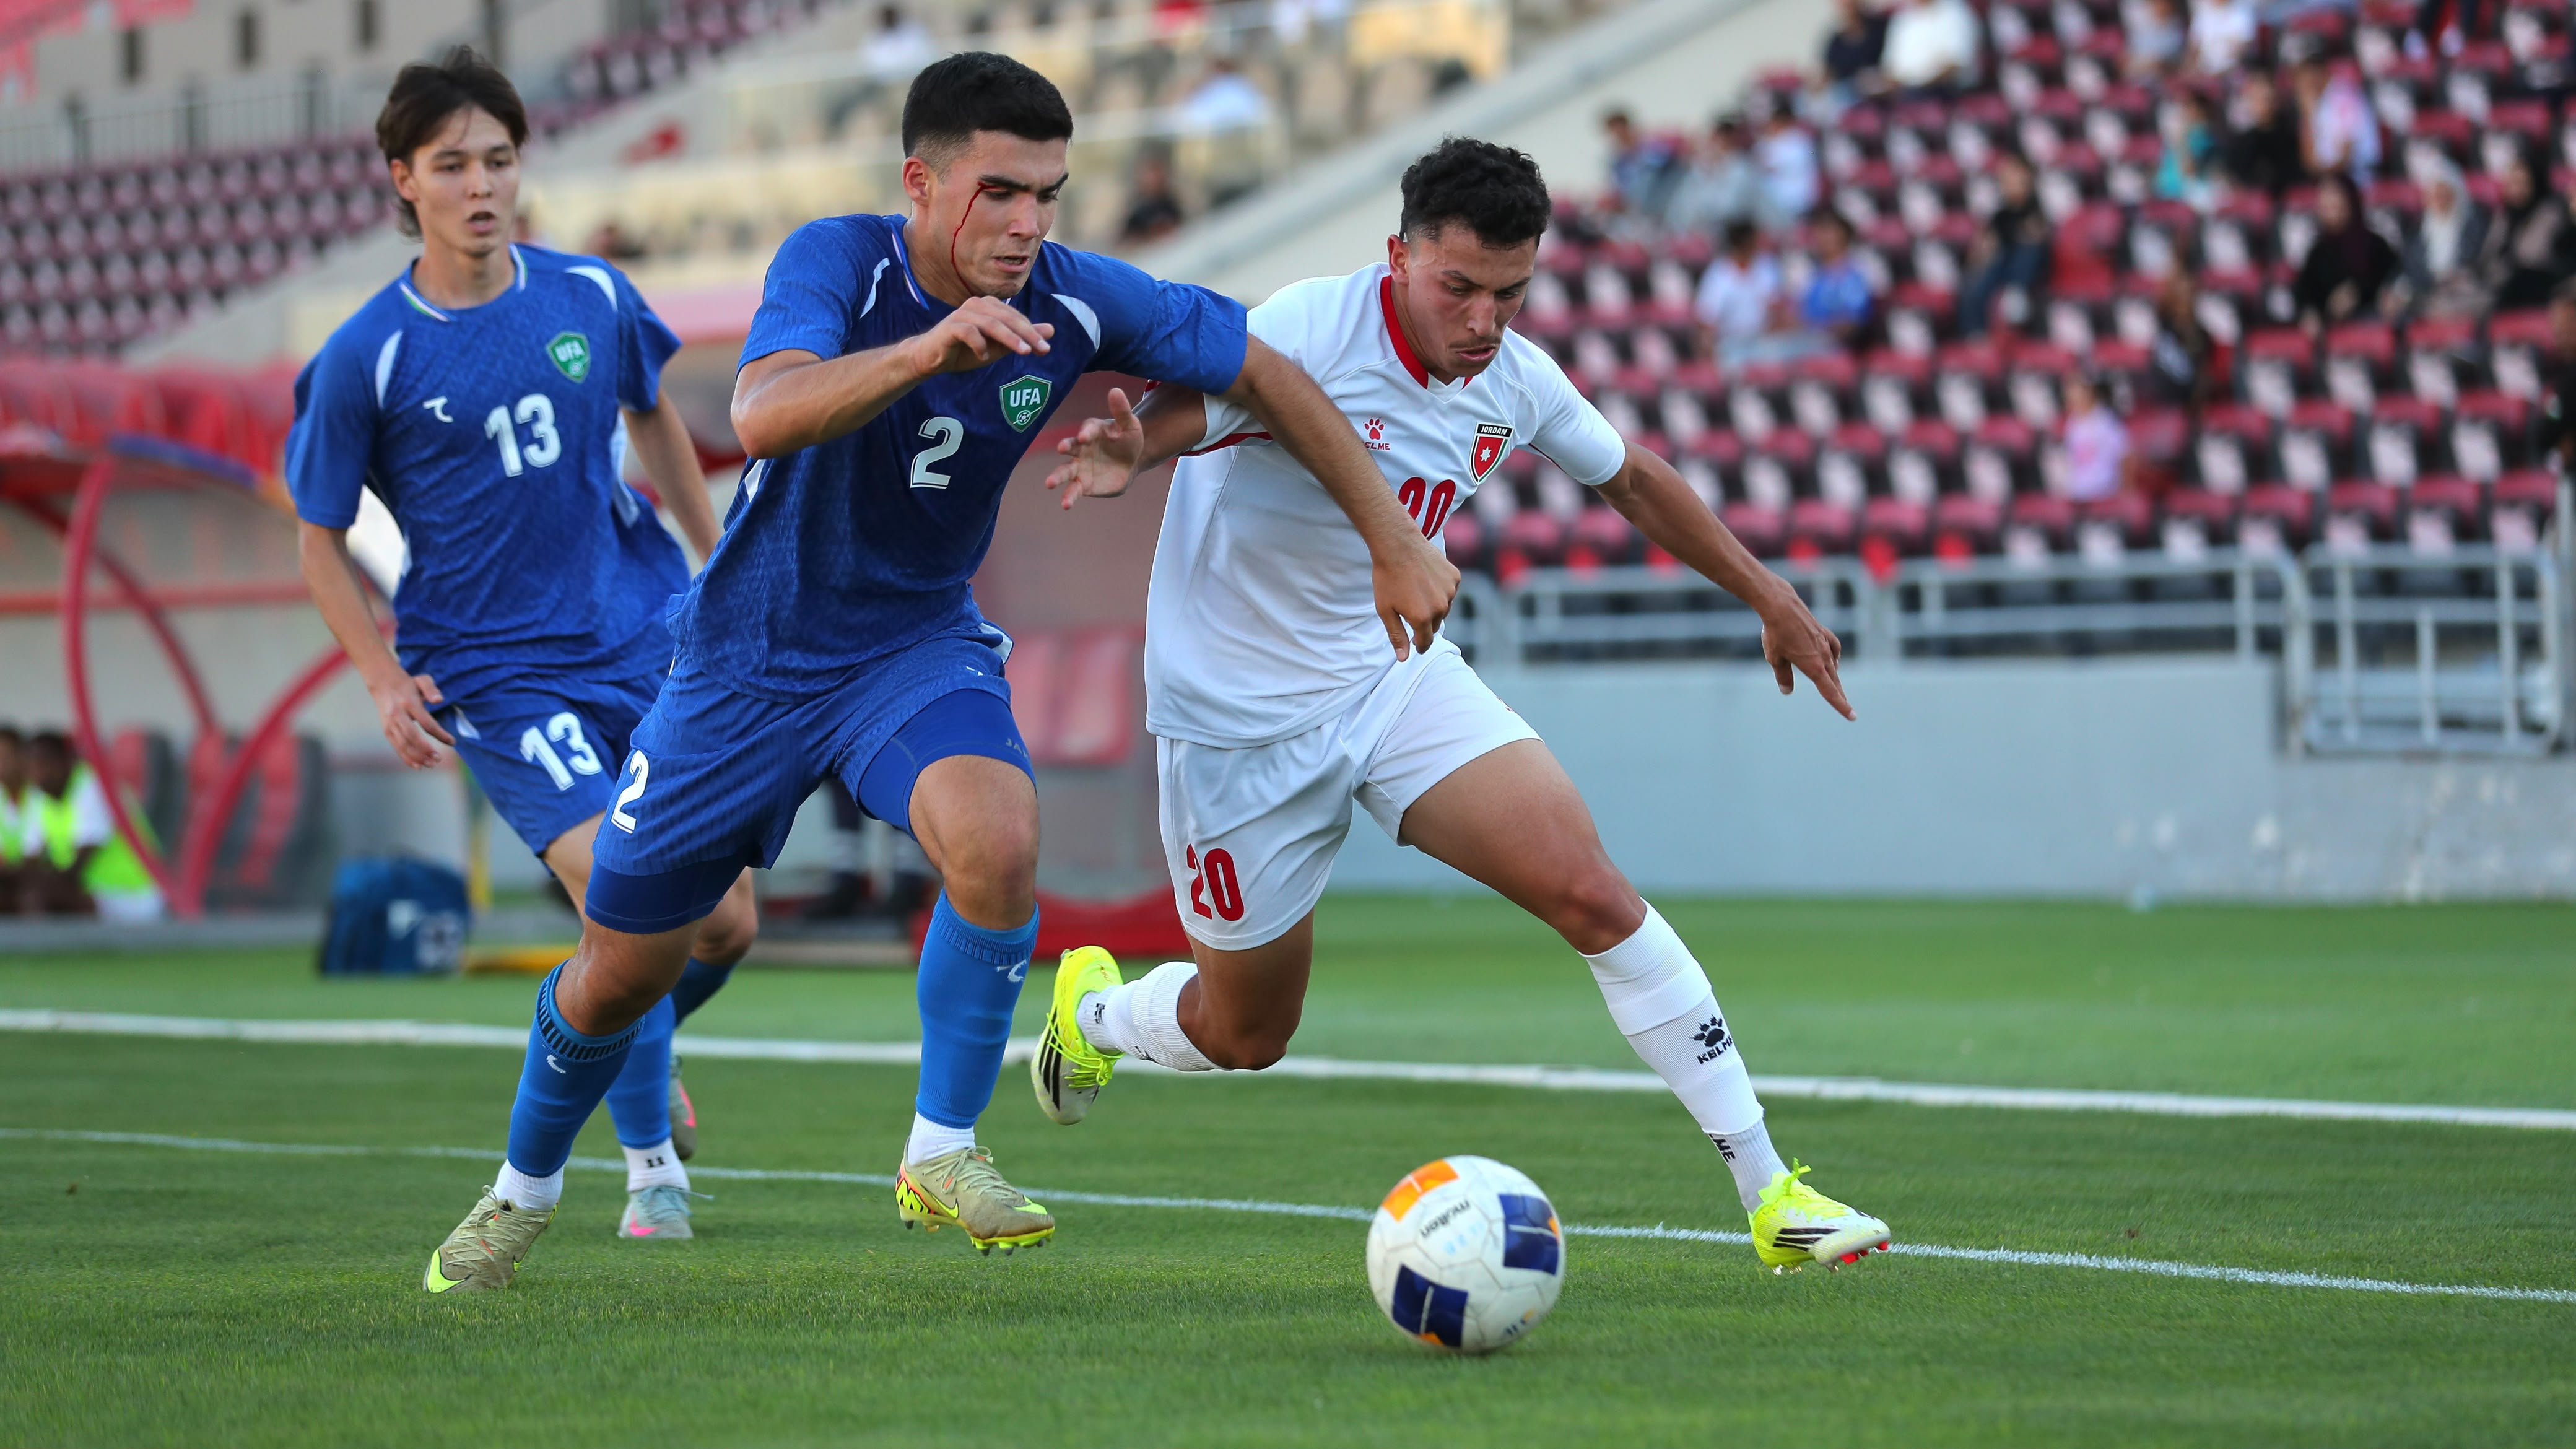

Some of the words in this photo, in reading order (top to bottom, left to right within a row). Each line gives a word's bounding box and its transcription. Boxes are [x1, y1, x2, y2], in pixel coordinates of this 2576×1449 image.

[555, 340, 585, 362] UFA
[1010, 388, 1041, 407] UFA
[1480, 425, 1508, 435] JORDAN
[483, 393, 562, 479] 13
[909, 416, 964, 490] 2
[1362, 441, 1391, 451] ELME
[519, 711, 603, 792] 13
[611, 749, 650, 835] 2
[1185, 843, 1245, 922] 20
